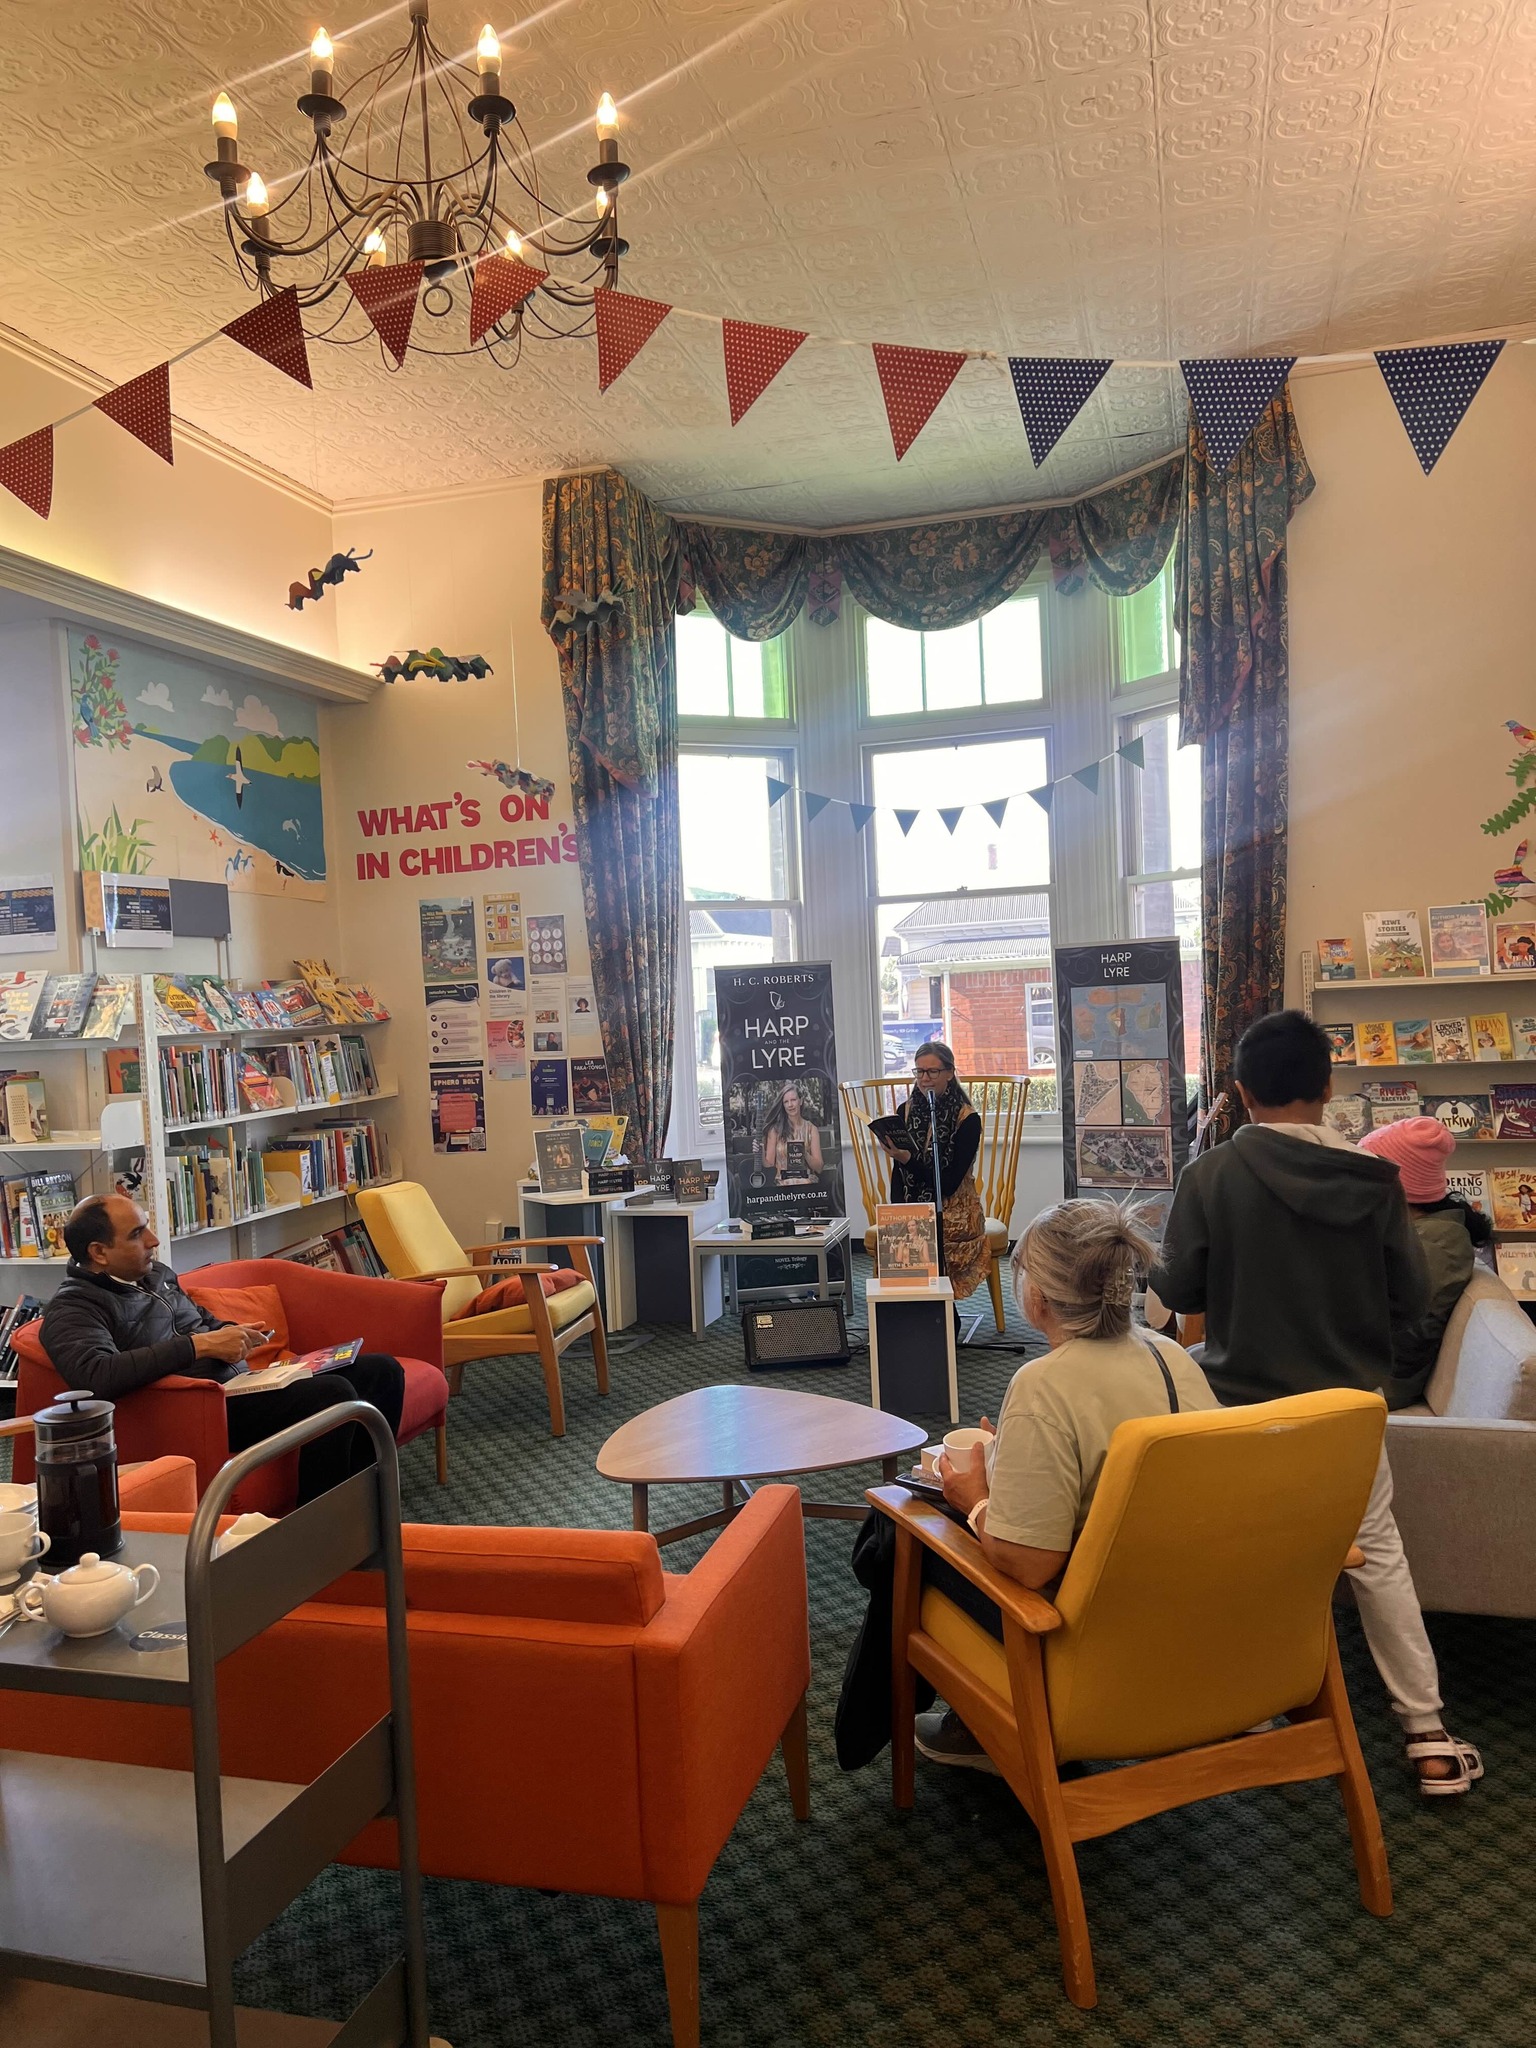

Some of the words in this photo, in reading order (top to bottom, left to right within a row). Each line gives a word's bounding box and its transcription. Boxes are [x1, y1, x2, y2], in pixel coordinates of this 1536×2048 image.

[357, 792, 481, 837] WHAT'S
[499, 794, 550, 823] ON
[356, 851, 390, 881] IN
[399, 822, 579, 877] CHILDREN'S
[1377, 925, 1407, 933] STORIES
[1101, 952, 1132, 963] HARP
[1103, 966, 1130, 978] LYRE
[733, 977, 745, 987] H.
[748, 976, 760, 986] C.
[763, 973, 815, 985] ROBERTS
[744, 1015, 810, 1039] HARP
[1435, 1021, 1462, 1032] LOCKED
[1439, 1027, 1463, 1037] DOWN
[751, 1046, 806, 1069] LYRE
[462, 1078, 480, 1086] BOLT
[1379, 1087, 1408, 1096] RIVER
[31, 1176, 45, 1187] BILL
[46, 1173, 72, 1185] BRYSON
[650, 1174, 671, 1182] HARP
[1494, 1168, 1520, 1181] RUSH!
[679, 1176, 701, 1185] HARP
[682, 1186, 701, 1195] LYRE
[746, 1191, 828, 1205] harpandthelyre.co.nz
